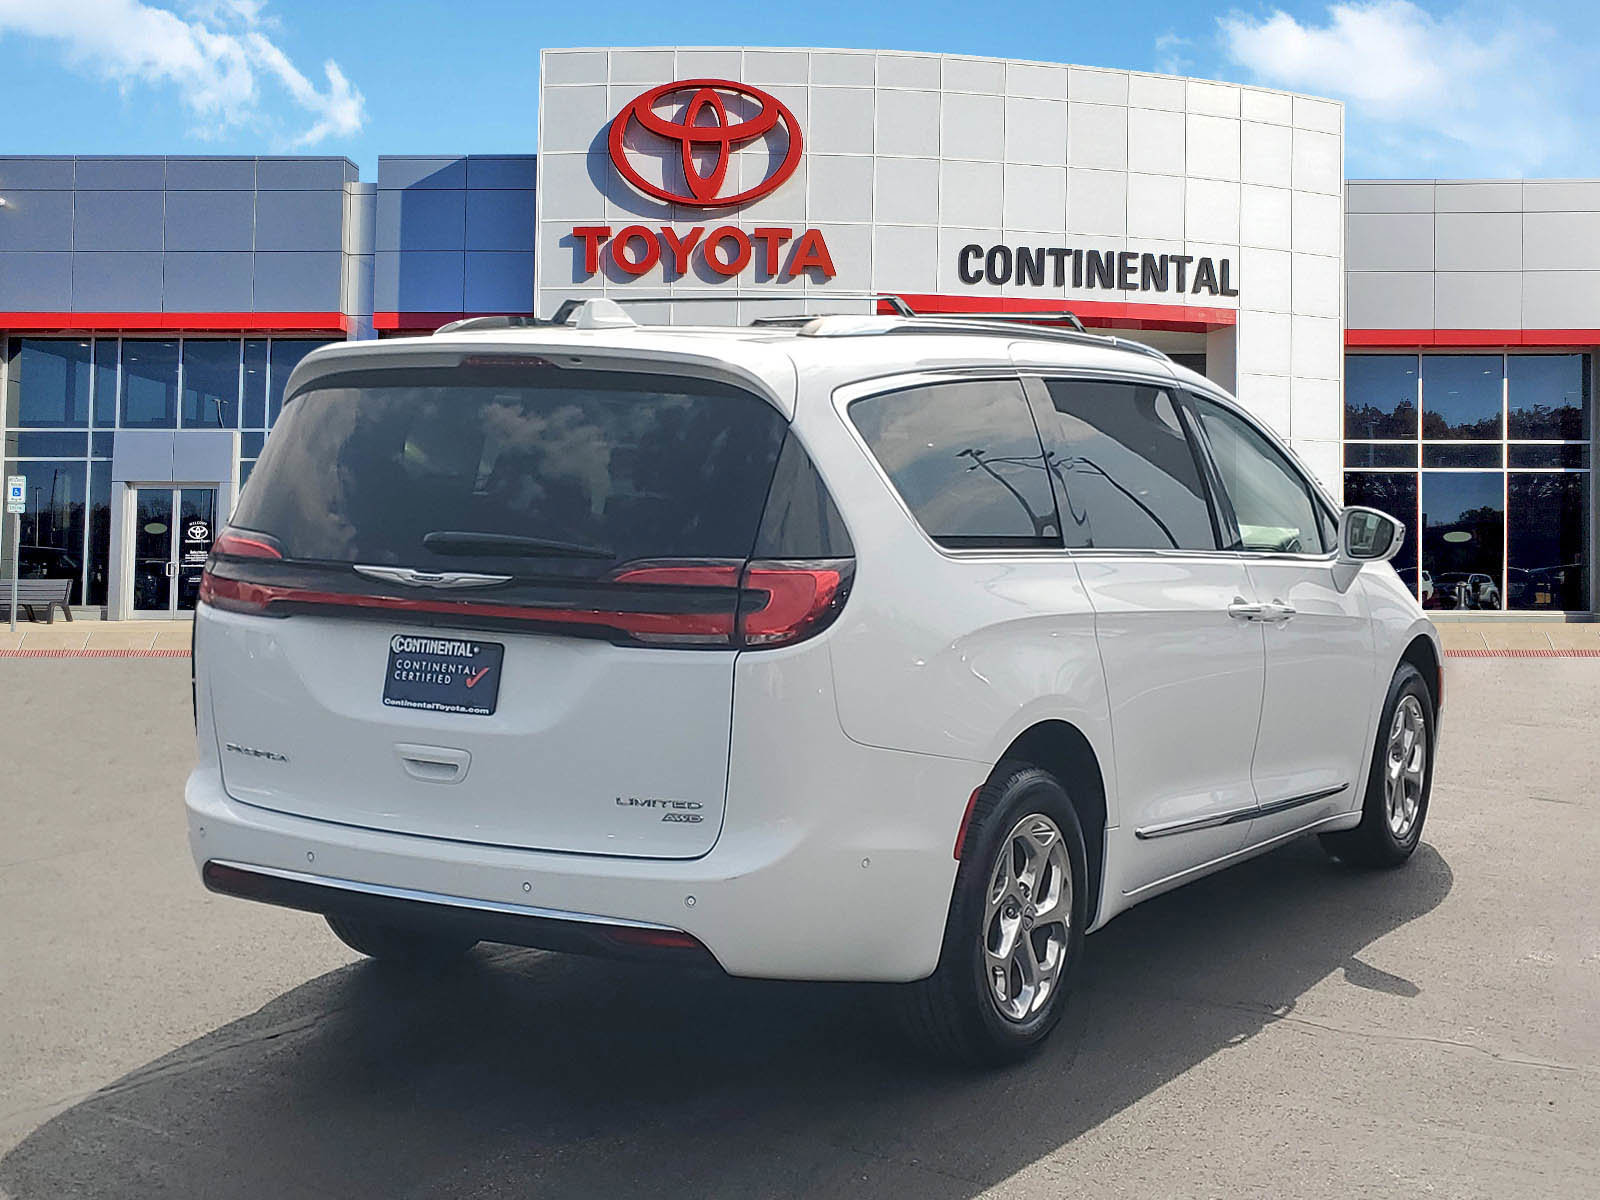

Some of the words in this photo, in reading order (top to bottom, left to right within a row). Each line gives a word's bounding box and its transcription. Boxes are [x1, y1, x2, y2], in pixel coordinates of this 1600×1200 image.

[573, 225, 836, 276] TOYOTA
[958, 244, 1239, 296] CONTINENTAL
[391, 636, 474, 658] CONTINENTAL
[396, 659, 477, 676] CONTINENTAL
[394, 670, 452, 685] CERTIFIED
[384, 698, 489, 715] ContinentalToyota.com
[616, 797, 703, 810] LIMITED
[661, 812, 704, 824] AWD
